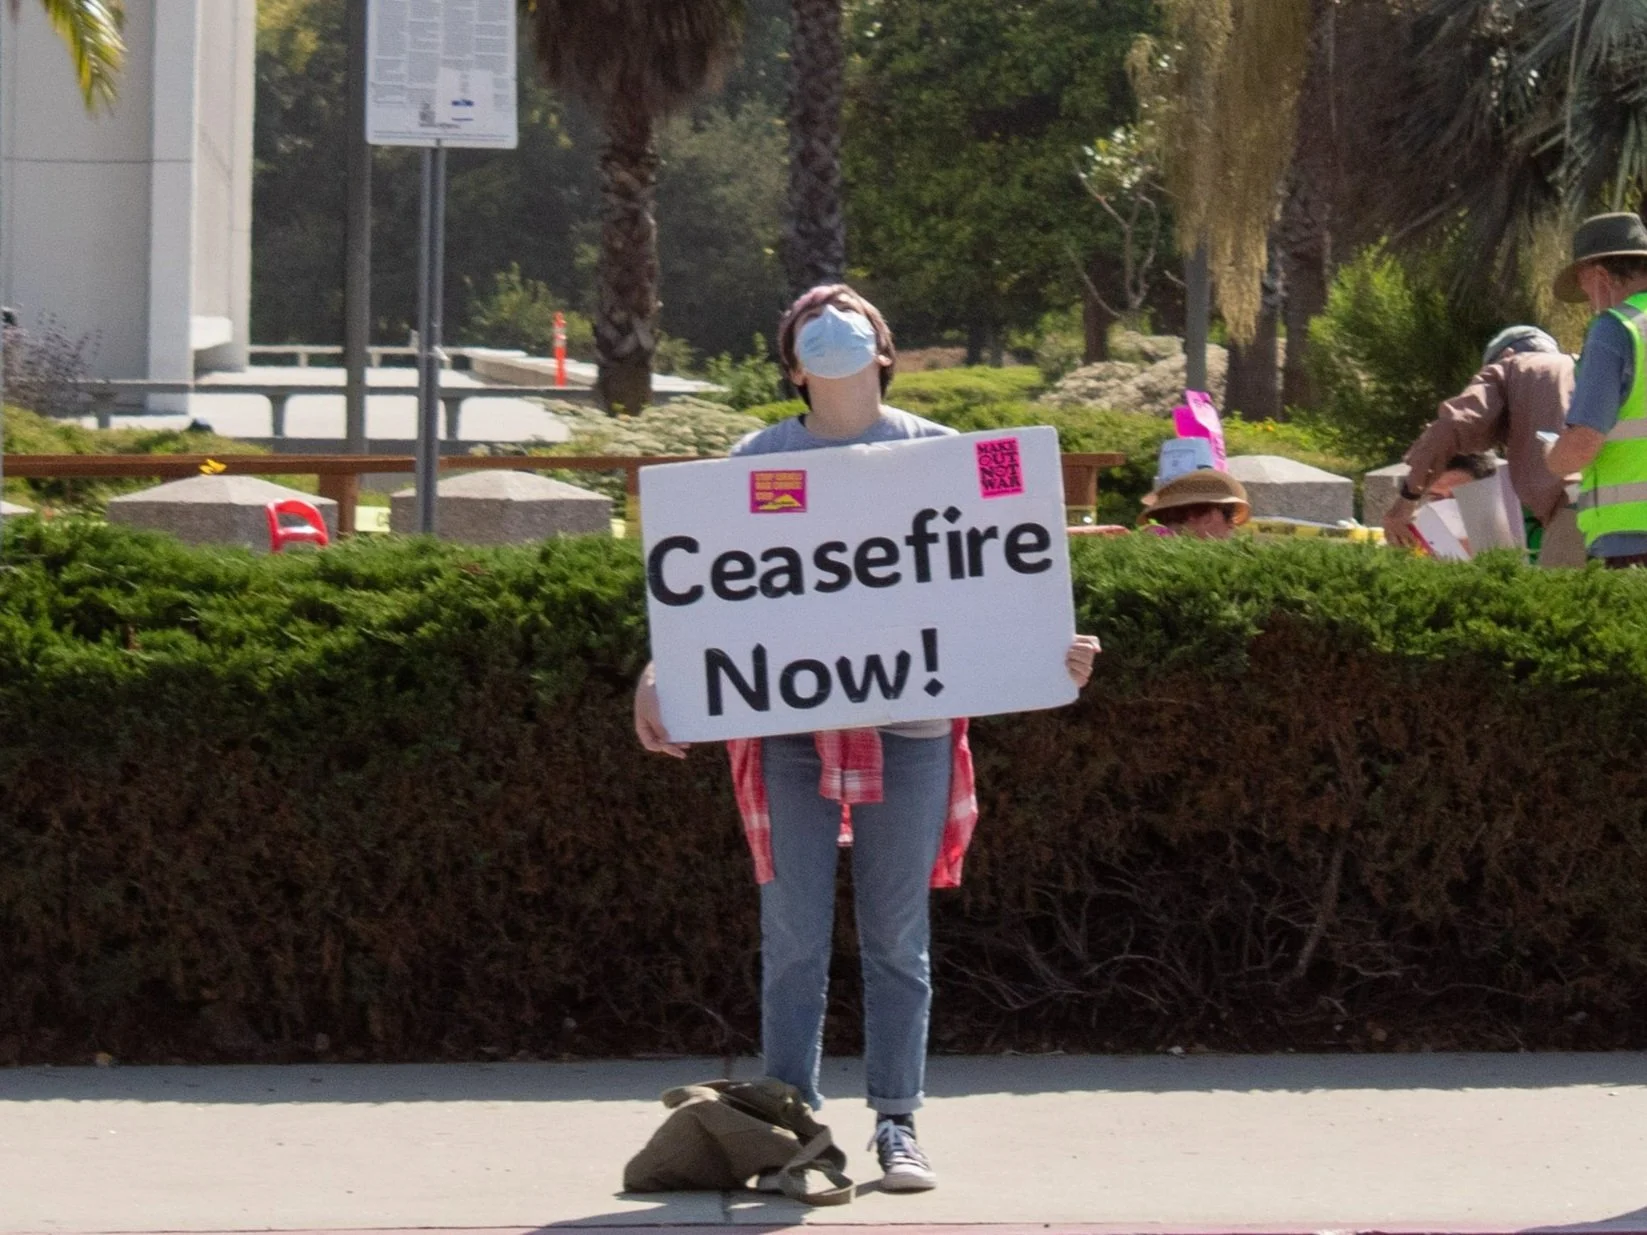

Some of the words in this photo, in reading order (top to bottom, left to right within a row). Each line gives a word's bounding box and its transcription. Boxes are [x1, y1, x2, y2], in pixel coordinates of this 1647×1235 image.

[976, 439, 1018, 454] MAKE
[979, 451, 1019, 466] OUT
[980, 464, 1020, 480] NOT
[981, 476, 1021, 490] WAR
[647, 506, 1053, 606] Ceasefire
[704, 628, 945, 717] Now!
